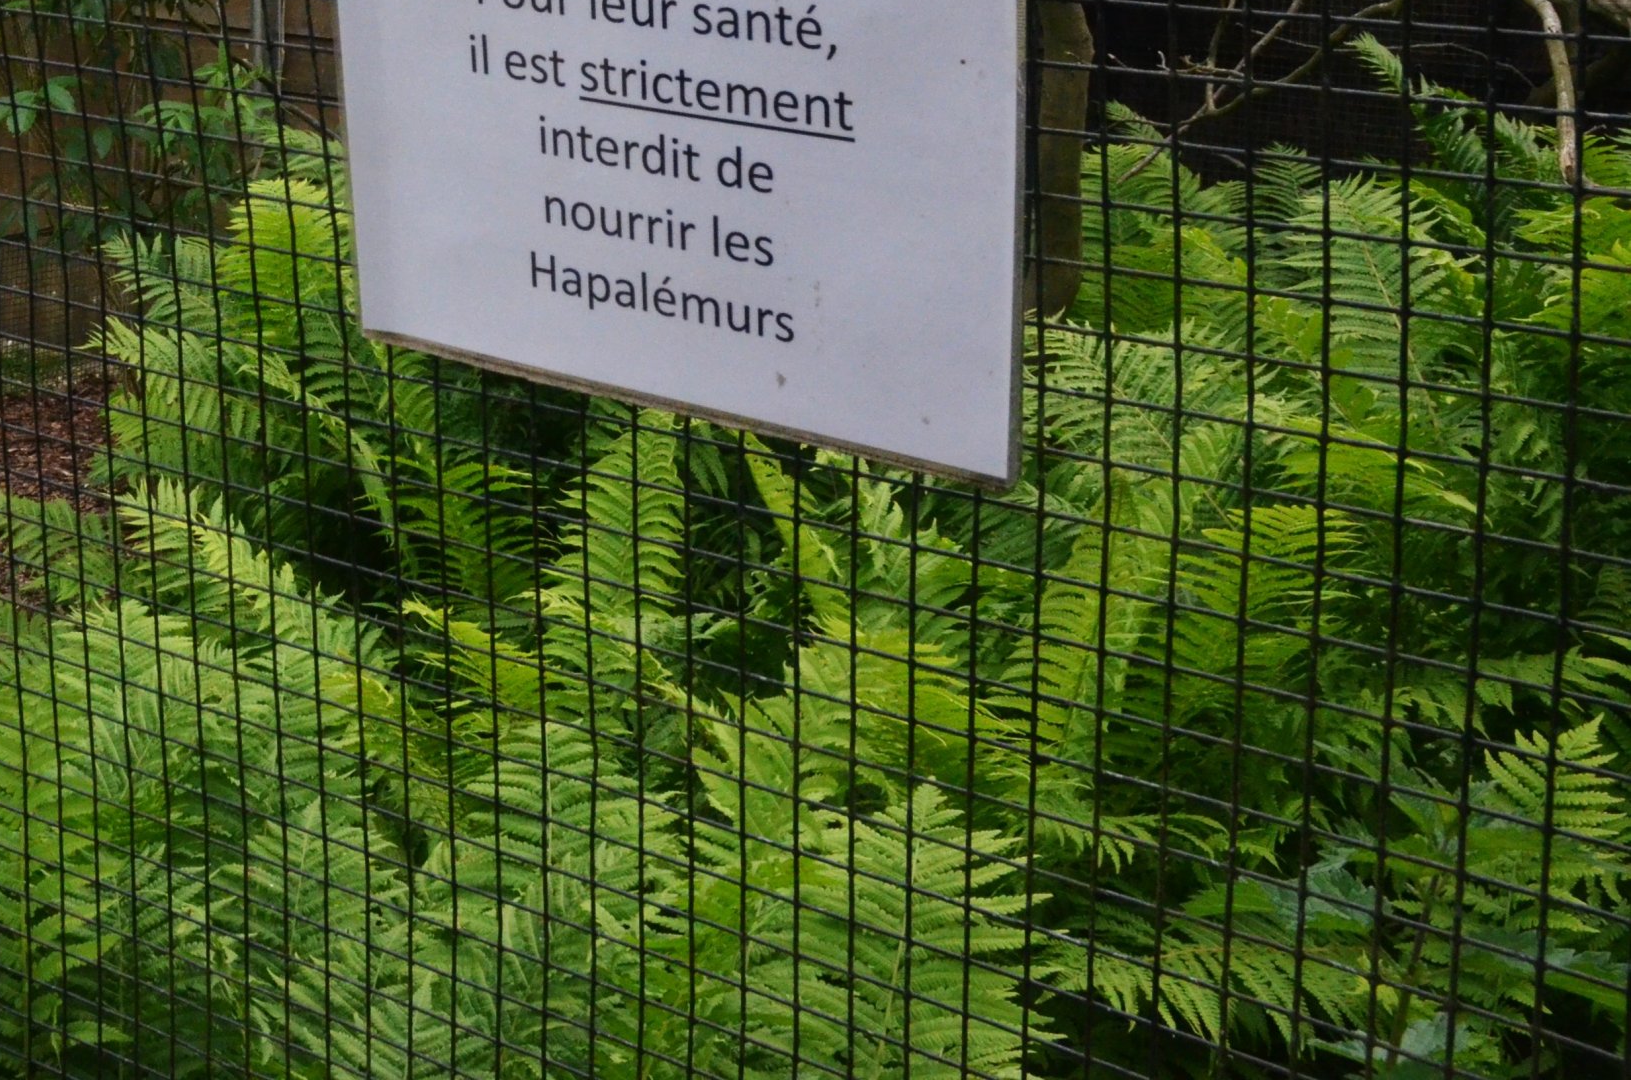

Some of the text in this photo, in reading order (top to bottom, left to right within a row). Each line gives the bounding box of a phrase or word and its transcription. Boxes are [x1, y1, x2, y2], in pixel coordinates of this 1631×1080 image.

[693, 3, 838, 59] santé,
[469, 35, 854, 132] il est strictement
[538, 116, 773, 194] interdit de
[544, 193, 773, 266] nourrir les
[530, 251, 795, 343] Hapalémurs
